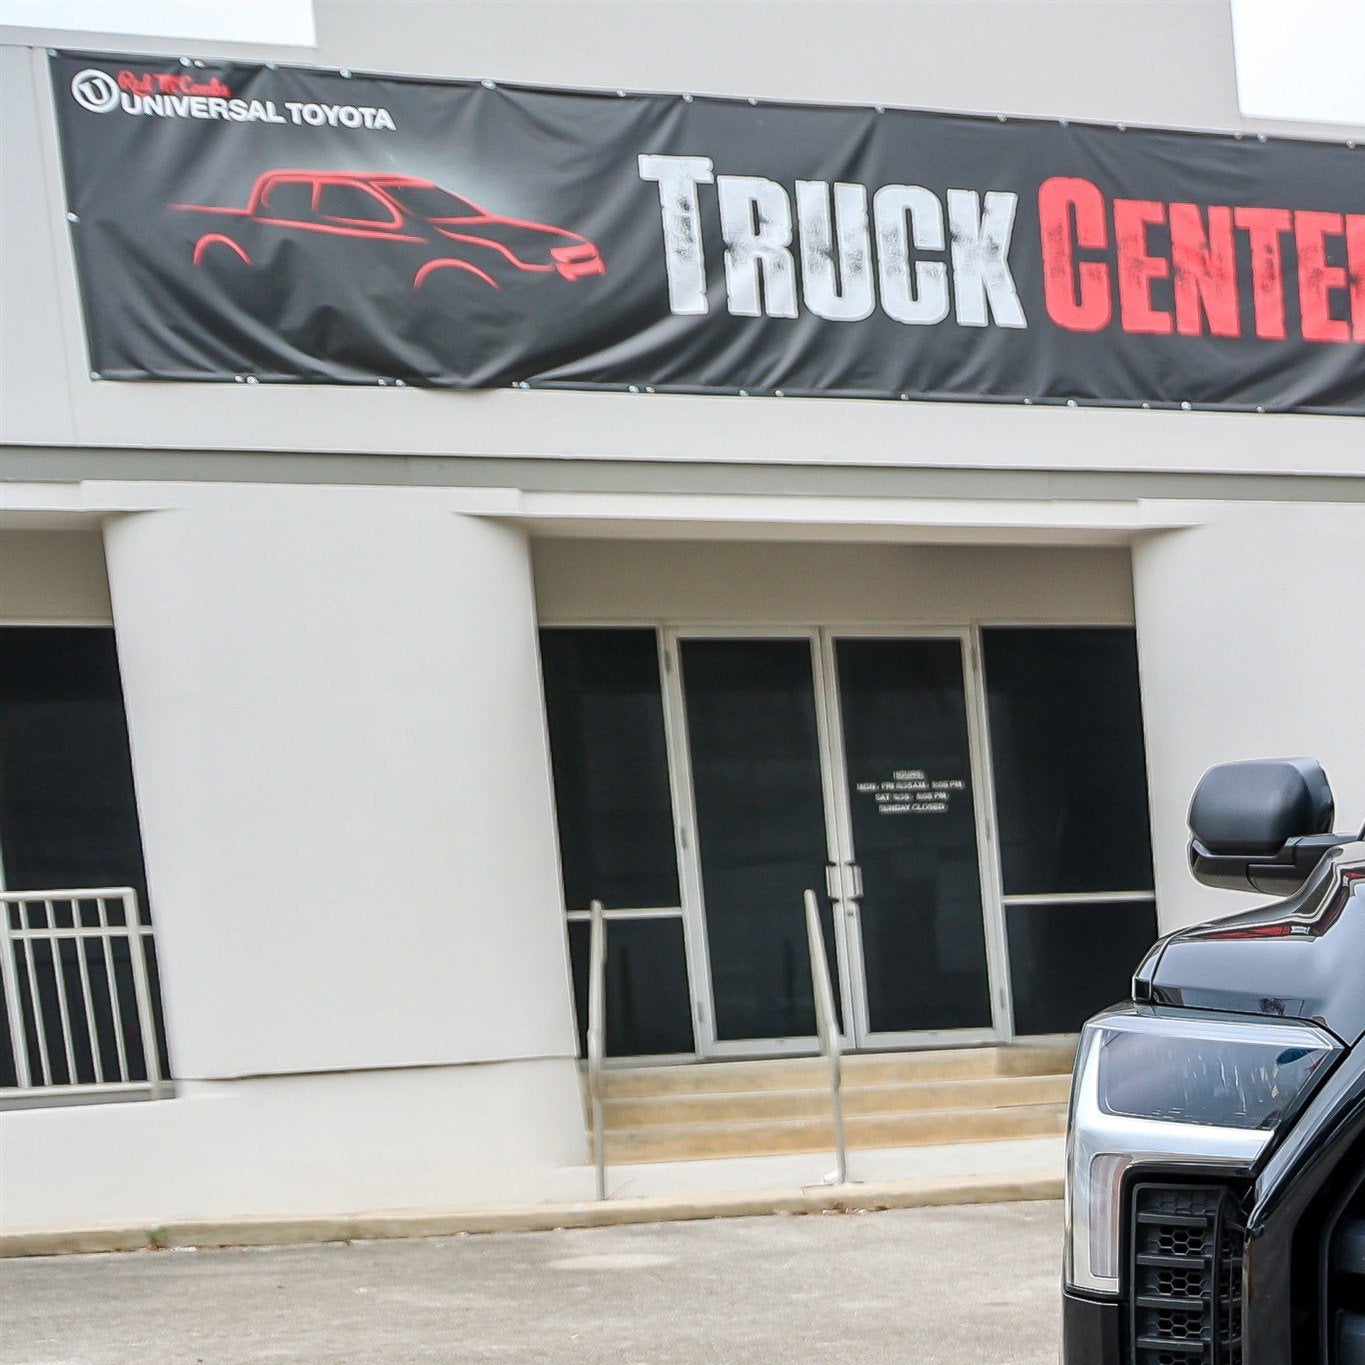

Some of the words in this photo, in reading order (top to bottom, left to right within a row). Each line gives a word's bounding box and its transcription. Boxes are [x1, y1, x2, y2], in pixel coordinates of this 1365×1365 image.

[120, 92, 287, 124] UNIVERSAL
[284, 102, 397, 131] TOYOTA
[638, 153, 1028, 329] TRUCK
